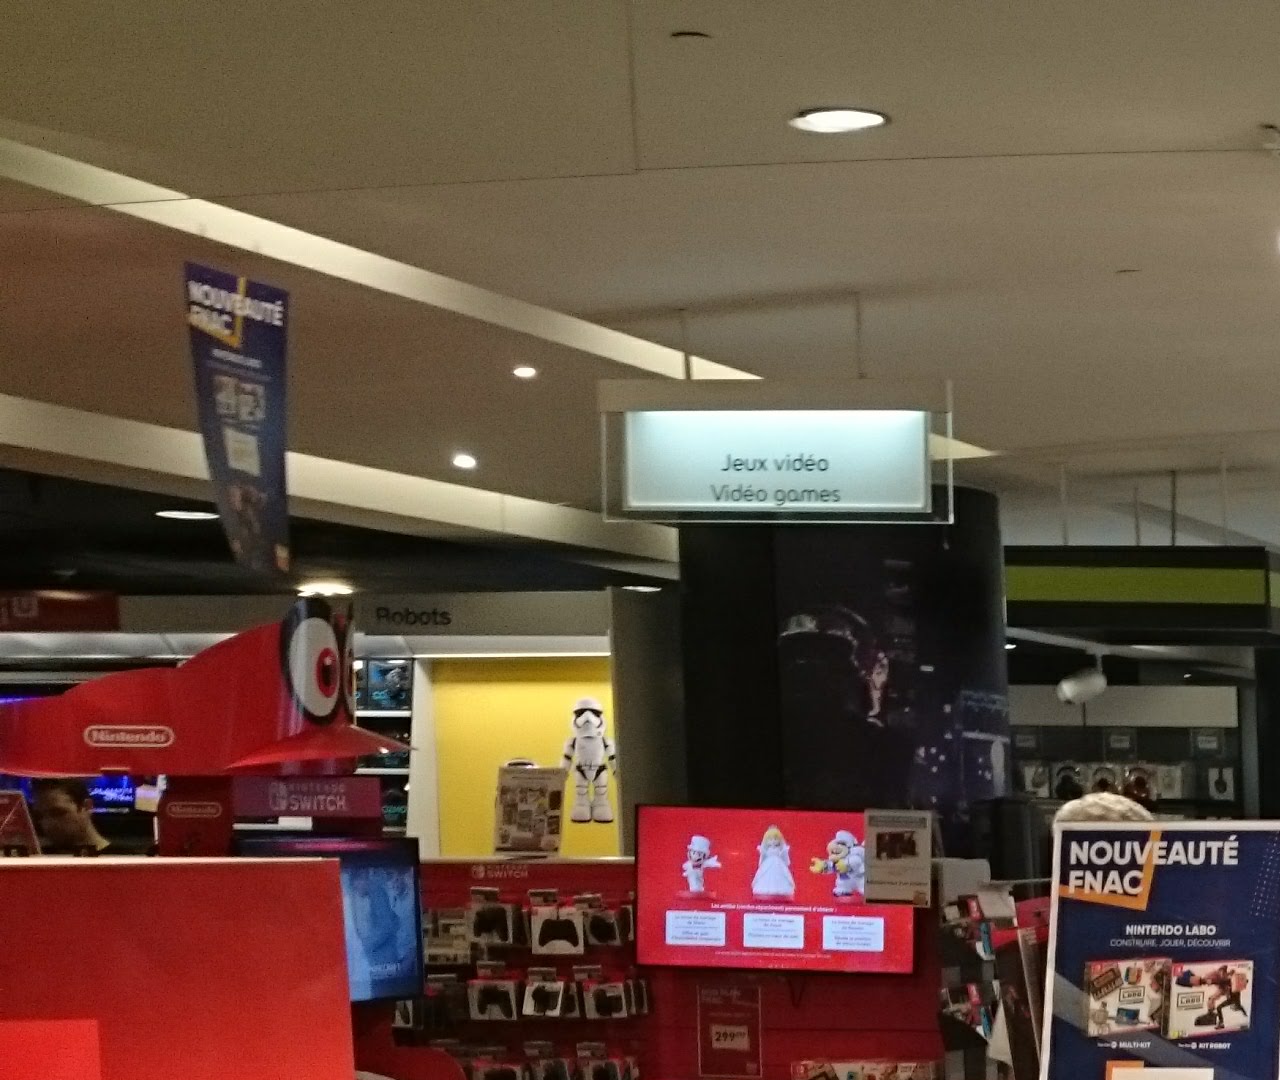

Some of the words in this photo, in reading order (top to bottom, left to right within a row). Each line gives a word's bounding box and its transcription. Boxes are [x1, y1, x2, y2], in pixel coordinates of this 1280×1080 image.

[721, 454, 768, 472] Jeux
[774, 453, 829, 472] vidéo
[710, 484, 767, 502] Vidéo
[774, 487, 841, 506] games
[376, 606, 452, 627] Robots
[92, 729, 165, 744] Nintendo
[289, 795, 348, 812] SWITCH
[1069, 835, 1239, 866] NOUVEAUTÉ
[1069, 869, 1144, 896] FNAC
[1126, 924, 1183, 937] NINTENDO
[1186, 924, 1217, 937] LABO
[1187, 937, 1231, 948] DÉCOUVRIR
